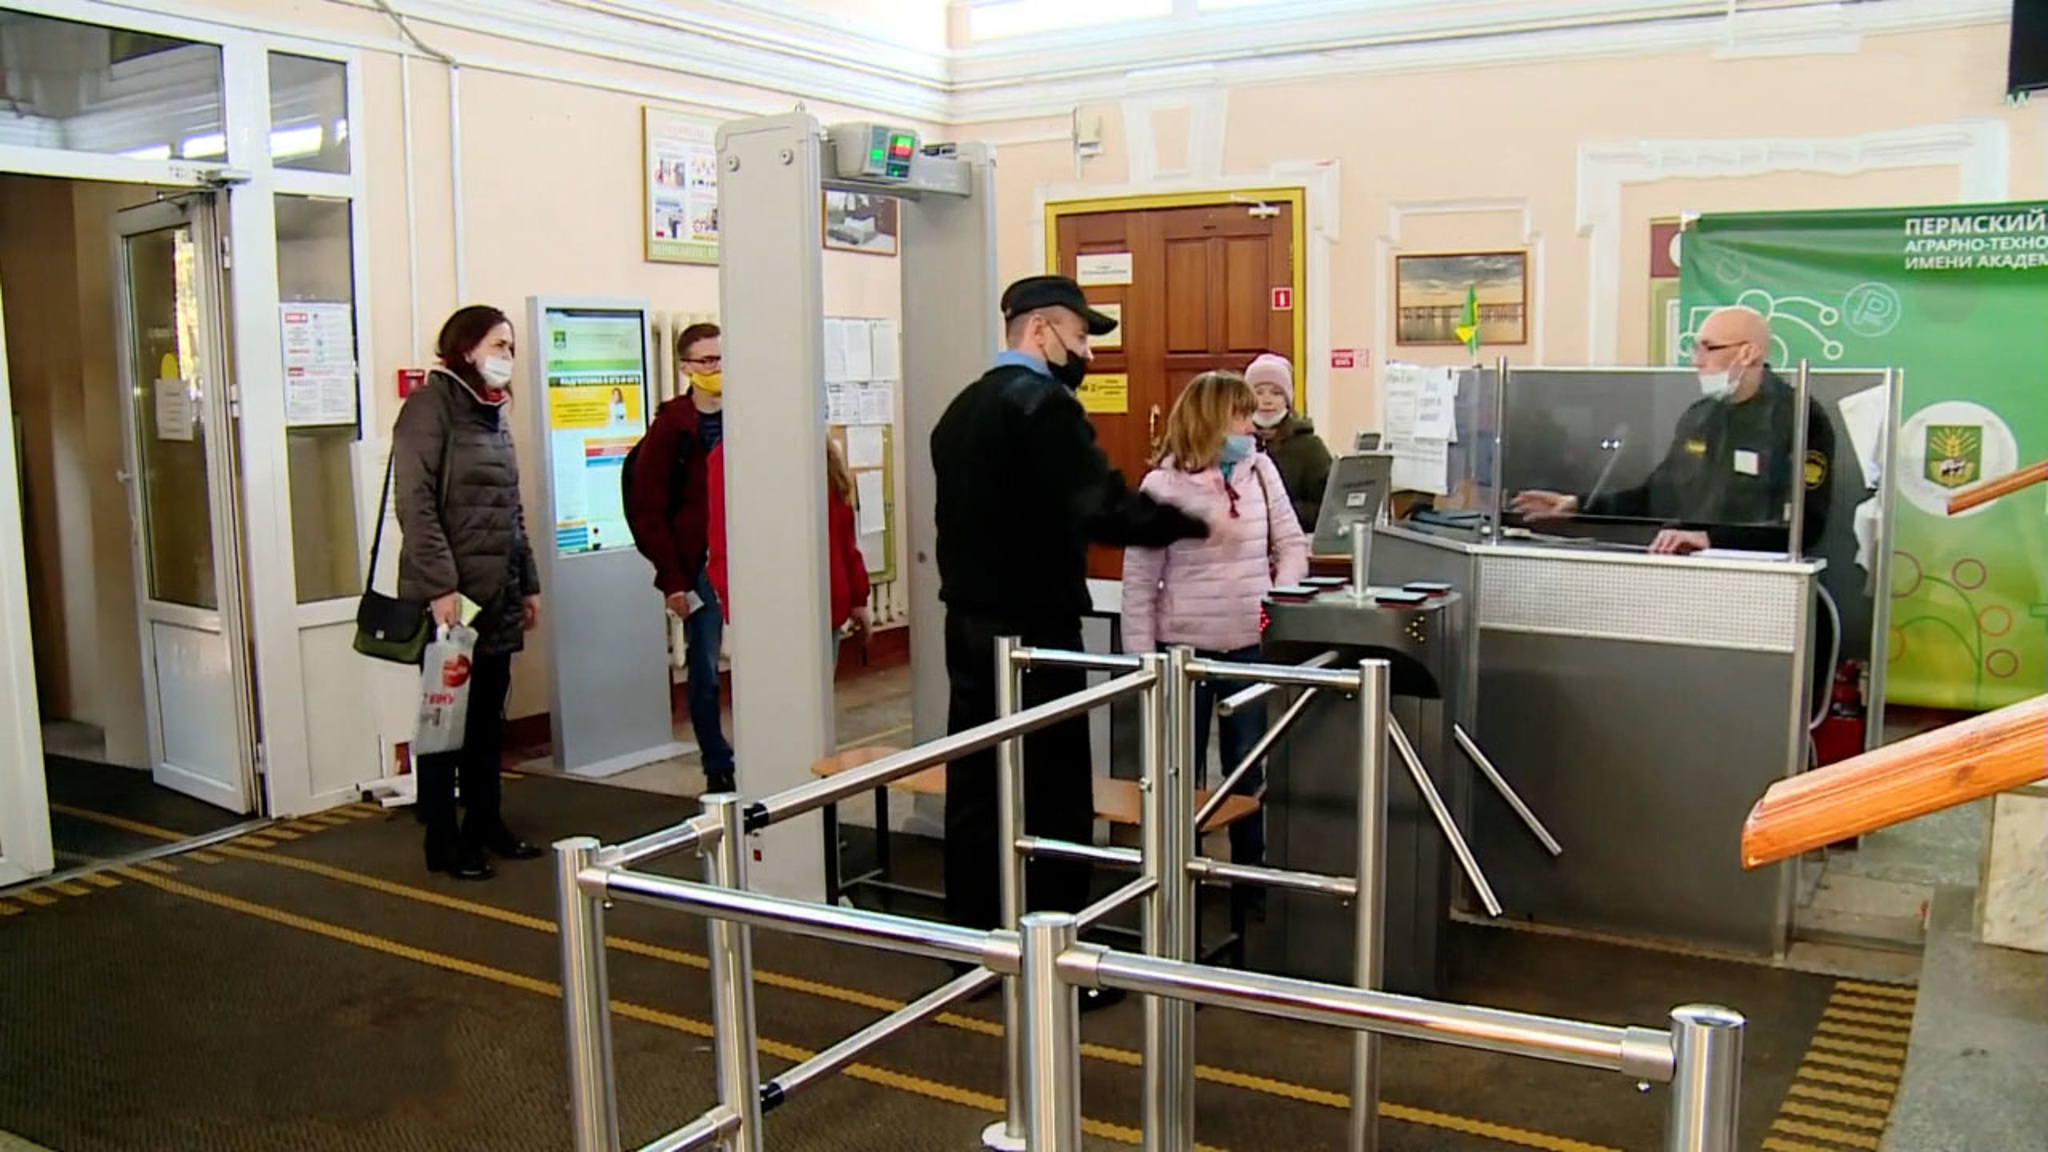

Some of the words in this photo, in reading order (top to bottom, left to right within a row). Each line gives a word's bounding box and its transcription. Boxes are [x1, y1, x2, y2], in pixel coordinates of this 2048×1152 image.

[1905, 208, 2046, 236] ПЕРМСКИЙ
[1904, 235, 2048, 253] АГРАРНО-ТЕХНО
[1905, 255, 1972, 270] ИМЕНИ
